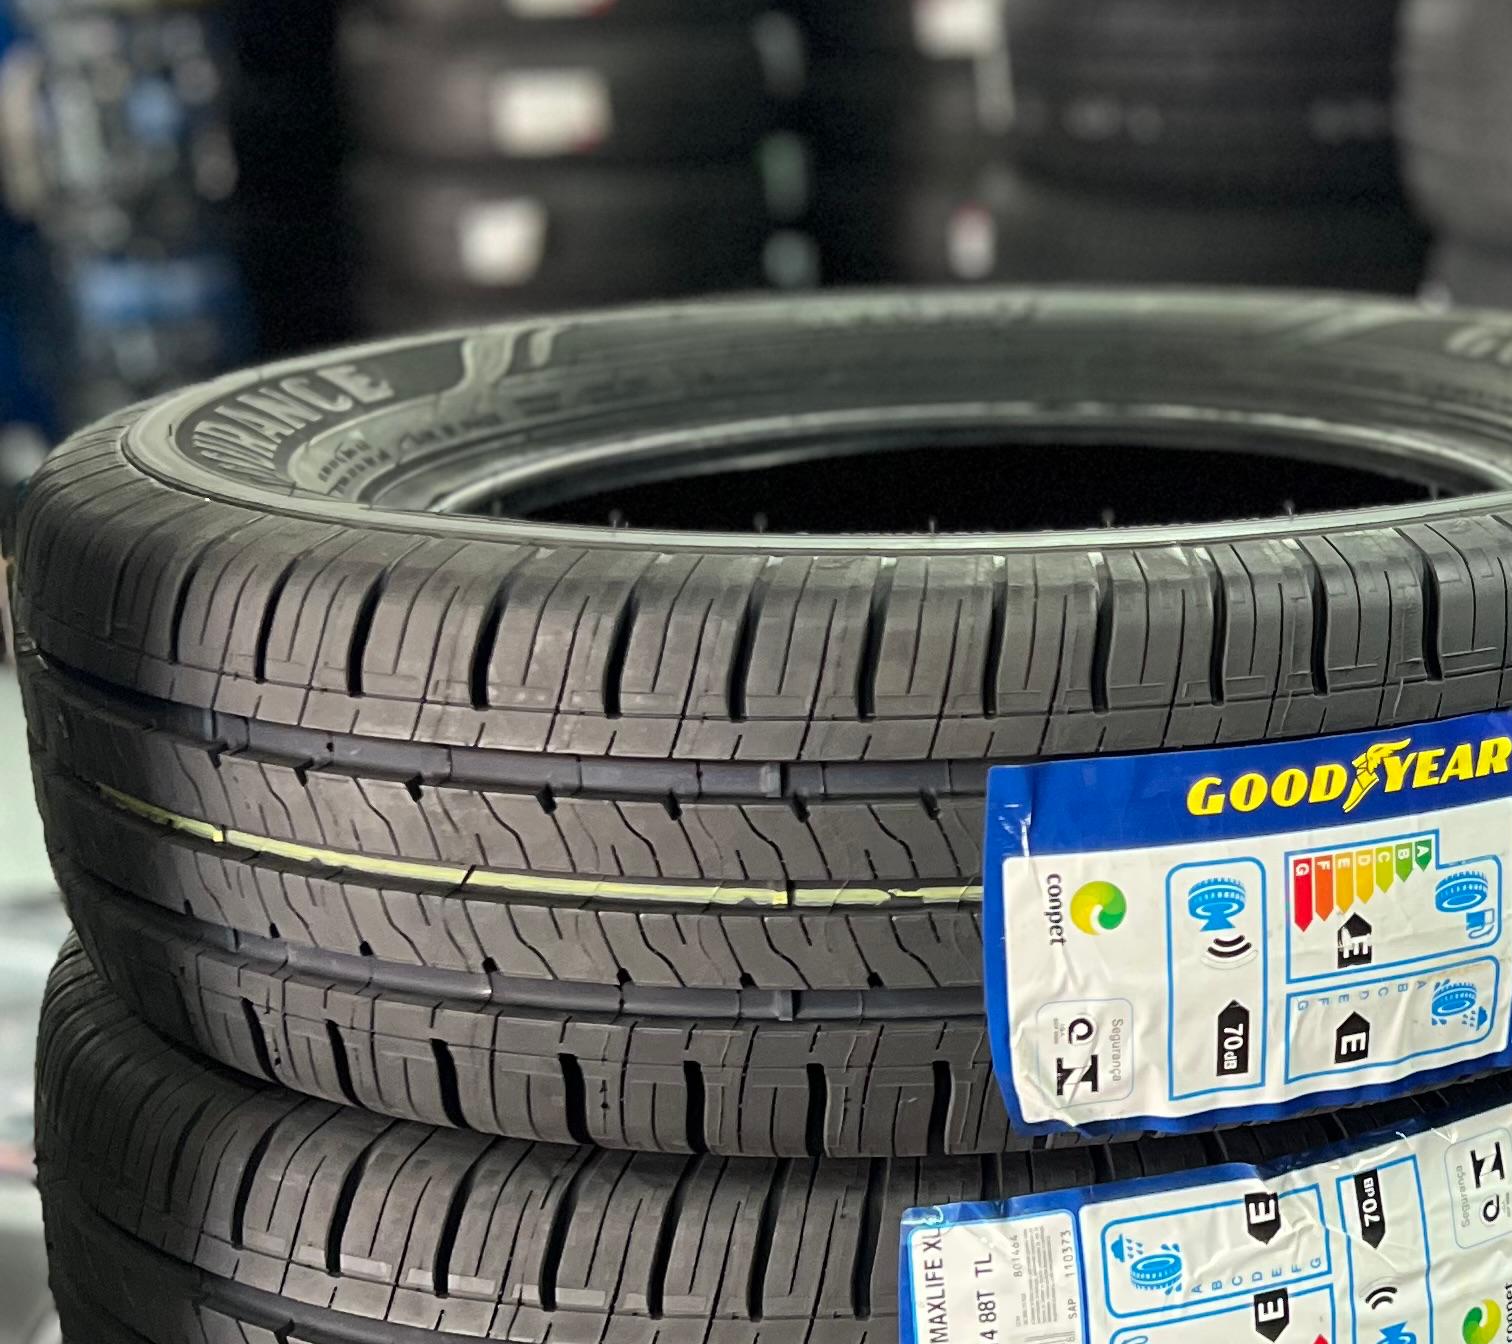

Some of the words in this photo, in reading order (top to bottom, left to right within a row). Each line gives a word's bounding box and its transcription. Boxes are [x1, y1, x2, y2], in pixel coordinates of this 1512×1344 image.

[1398, 848, 1409, 859] B
[1416, 845, 1429, 857] A
[1358, 854, 1371, 865] D
[1377, 851, 1390, 863] C
[1317, 861, 1330, 870] F
[1338, 858, 1350, 868] E
[1295, 863, 1310, 876] G
[1044, 874, 1067, 946] conpet
[1398, 983, 1408, 992] B
[1417, 980, 1427, 989] A
[1359, 991, 1370, 1000] D
[1378, 987, 1389, 997] C
[1320, 997, 1329, 1005] F
[1339, 994, 1349, 1003] E
[1298, 1000, 1309, 1011] G
[1224, 1023, 1243, 1069] 70dB
[1341, 1032, 1366, 1055] E
[1109, 1018, 1124, 1082] Segurança
[1454, 1164, 1471, 1228] Segurança
[1362, 1177, 1380, 1227] 70dB
[1248, 1199, 1276, 1224] E
[922, 1228, 942, 1252] XL
[1010, 1234, 1024, 1278] 801464
[1060, 1230, 1075, 1278] 110373
[974, 1253, 994, 1278] TL
[1310, 1257, 1321, 1268] G
[1272, 1268, 1282, 1277] E
[1291, 1264, 1302, 1273] F
[1232, 1276, 1243, 1286] C
[1252, 1271, 1263, 1282] D
[1191, 1284, 1202, 1293] A
[1212, 1280, 1222, 1290] B
[923, 1259, 949, 1343] MAXLIFE
[976, 1289, 996, 1323] 88T
[1067, 1297, 1078, 1320] SAP
[1258, 1297, 1284, 1322] E
